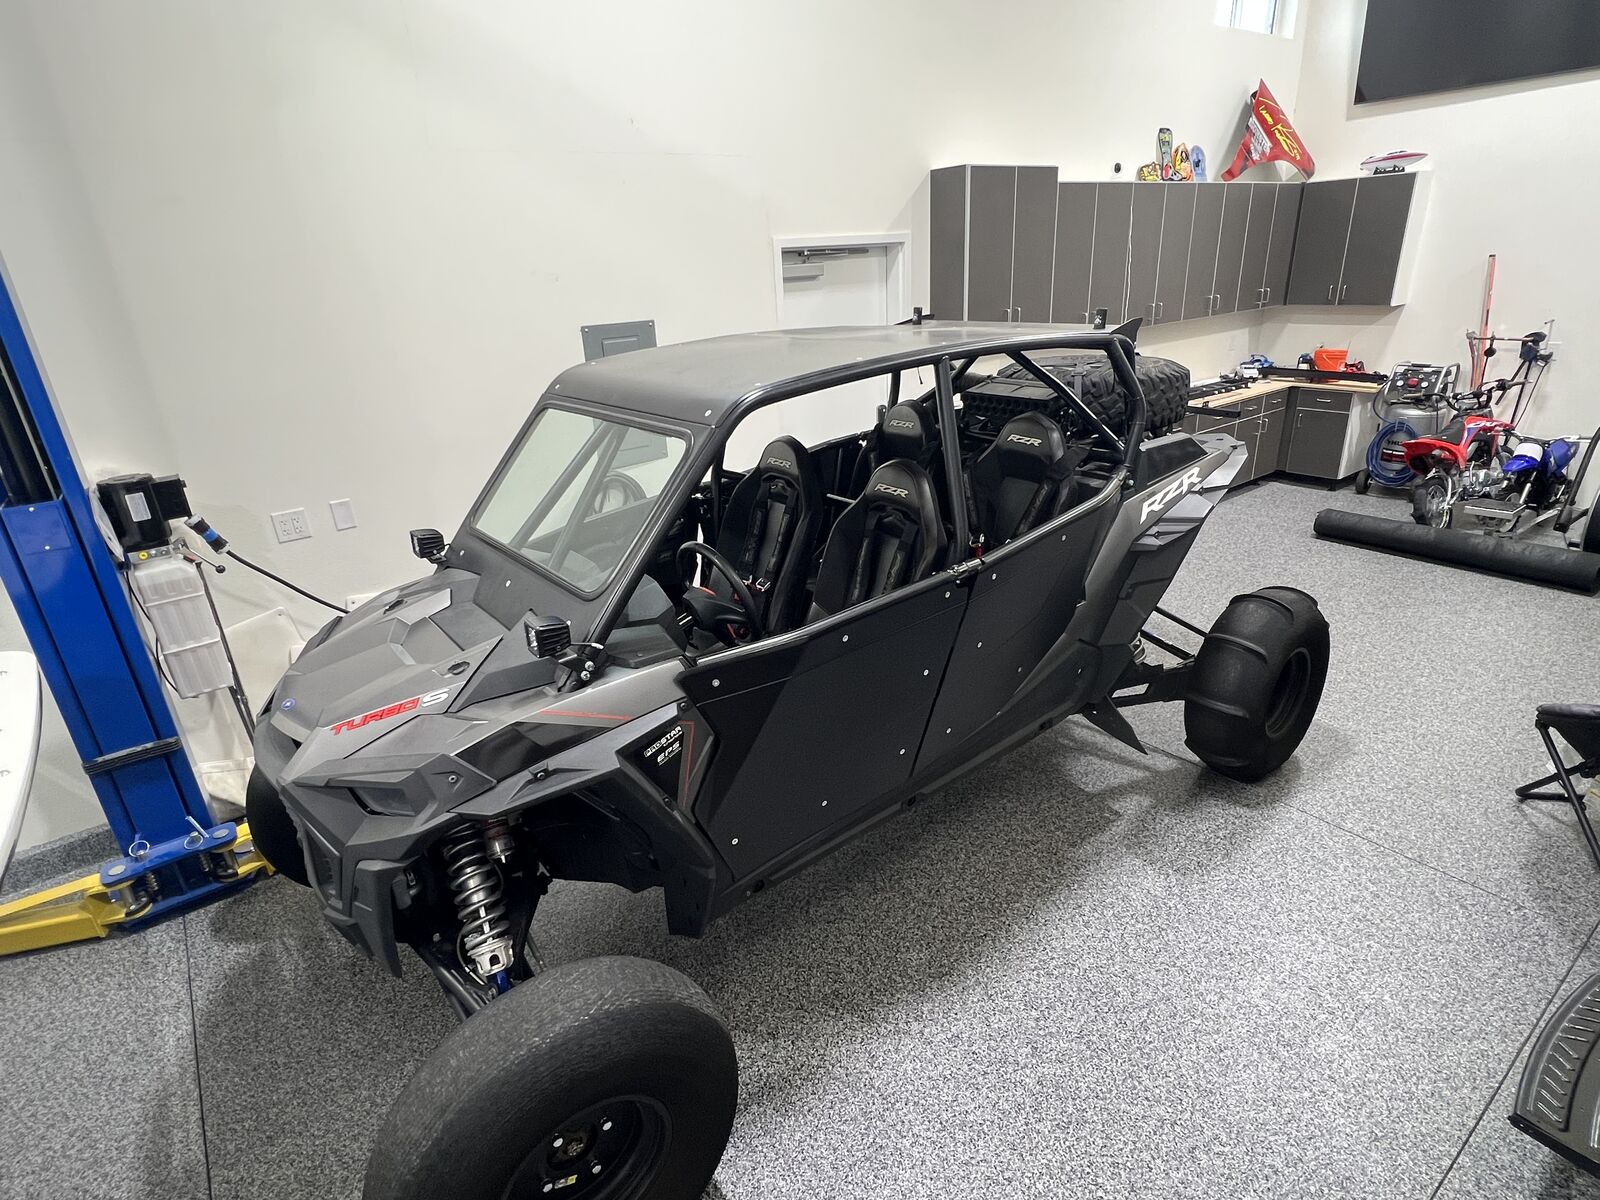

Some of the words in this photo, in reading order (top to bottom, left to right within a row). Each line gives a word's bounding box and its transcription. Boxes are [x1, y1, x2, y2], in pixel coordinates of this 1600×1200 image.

[889, 419, 915, 429] RZR
[1006, 434, 1043, 447] RZR
[766, 457, 792, 469] RZR
[874, 483, 909, 498] RZR
[1139, 466, 1203, 525] RZR
[330, 697, 421, 736] TURBO
[421, 688, 451, 708] S
[643, 725, 683, 758] PROSTAR
[657, 741, 681, 763] EPS
